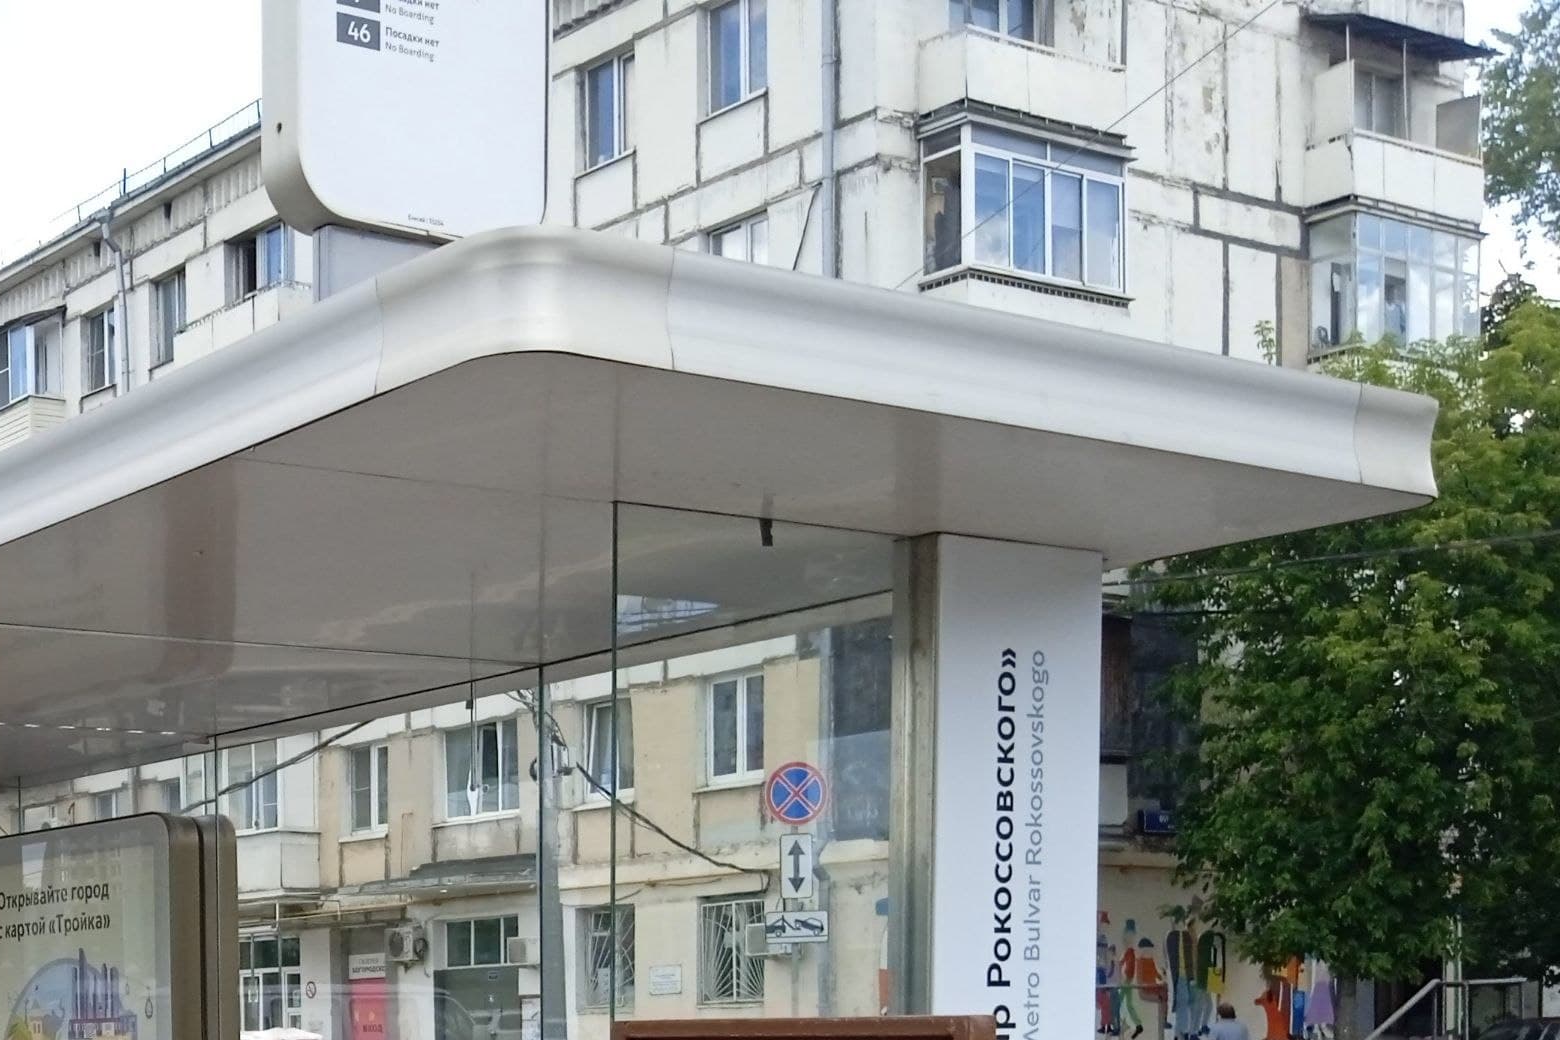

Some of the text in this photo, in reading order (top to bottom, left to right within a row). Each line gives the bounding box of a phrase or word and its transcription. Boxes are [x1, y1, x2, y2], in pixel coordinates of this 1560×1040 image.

[347, 20, 371, 43] 46
[385, 27, 423, 43] Посадки
[1024, 649, 1049, 866] Rokossovskogo
[986, 647, 1016, 987] Рокоссовского»
[70, 883, 110, 905] город
[4, 916, 46, 942] картой
[48, 911, 111, 936] «Тройка»
[1023, 874, 1042, 962] Bulvar
